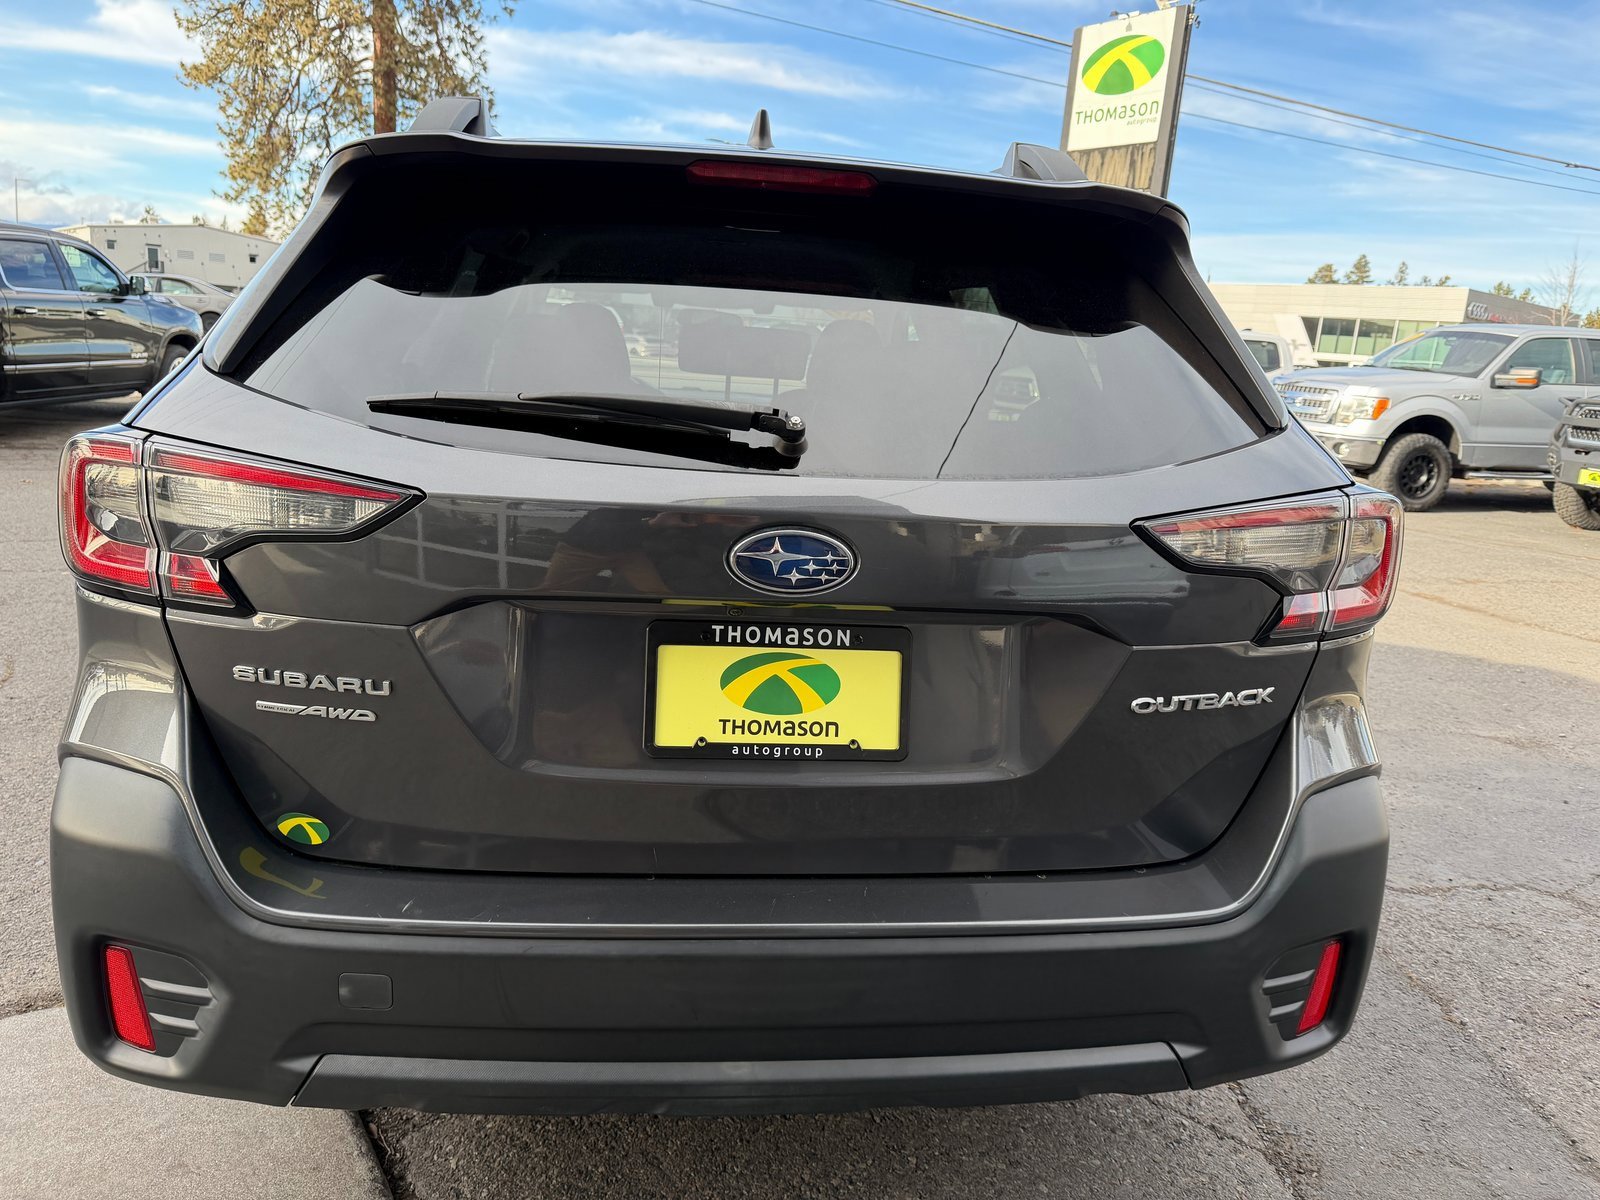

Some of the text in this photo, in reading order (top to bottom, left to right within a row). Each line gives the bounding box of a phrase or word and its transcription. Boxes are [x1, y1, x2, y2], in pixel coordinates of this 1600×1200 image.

[232, 665, 392, 696] SUBARU
[1131, 686, 1275, 714] OUTBACK
[298, 705, 377, 721] AWD
[731, 745, 824, 758] autogroup
